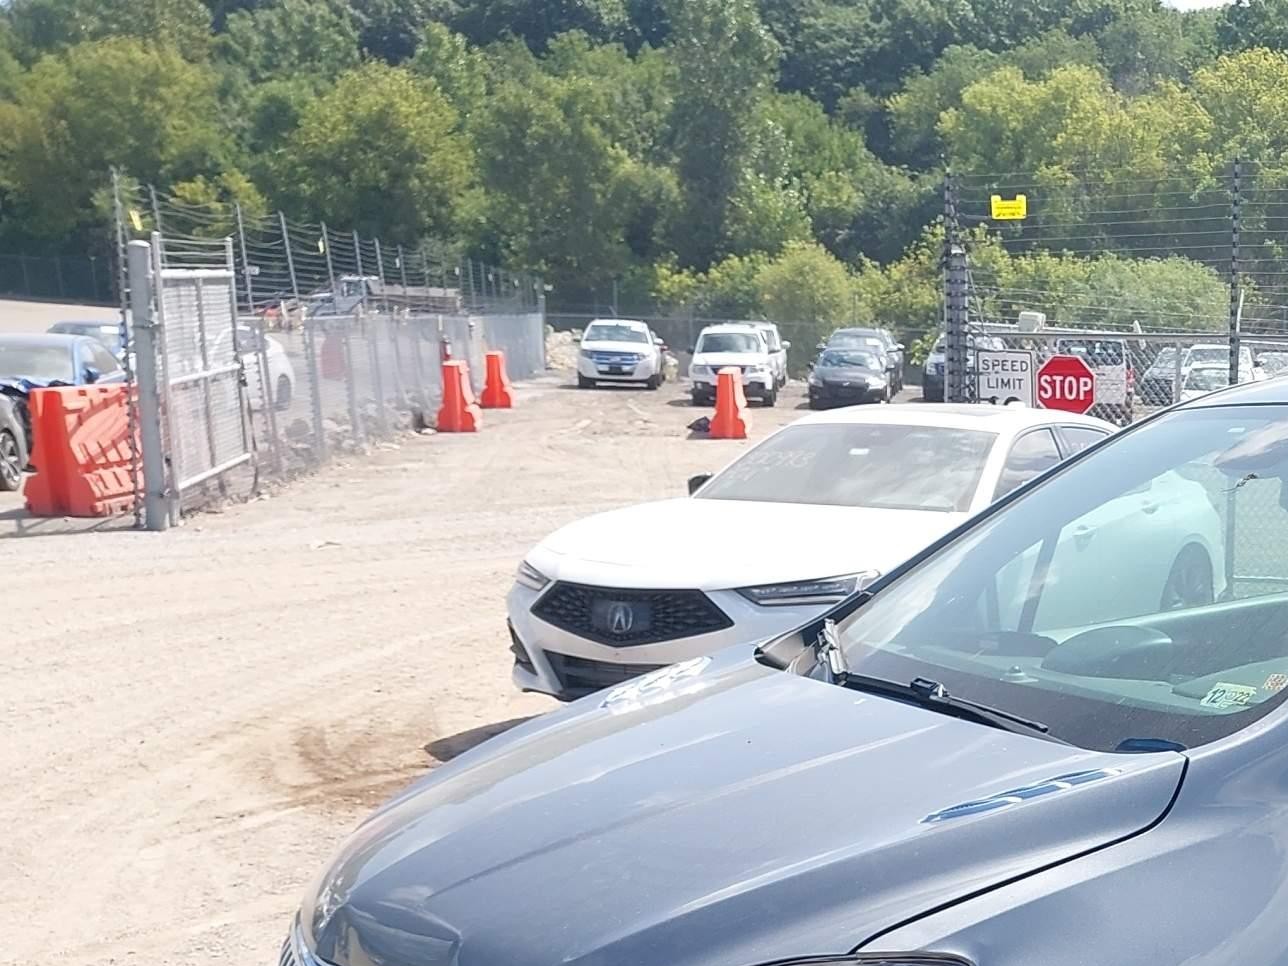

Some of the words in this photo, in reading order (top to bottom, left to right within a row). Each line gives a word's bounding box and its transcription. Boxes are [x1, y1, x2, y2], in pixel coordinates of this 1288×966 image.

[982, 359, 1029, 372] SPEED
[987, 377, 1024, 390] LIMIT
[1039, 374, 1092, 401] STOP
[1206, 688, 1226, 704] 12
